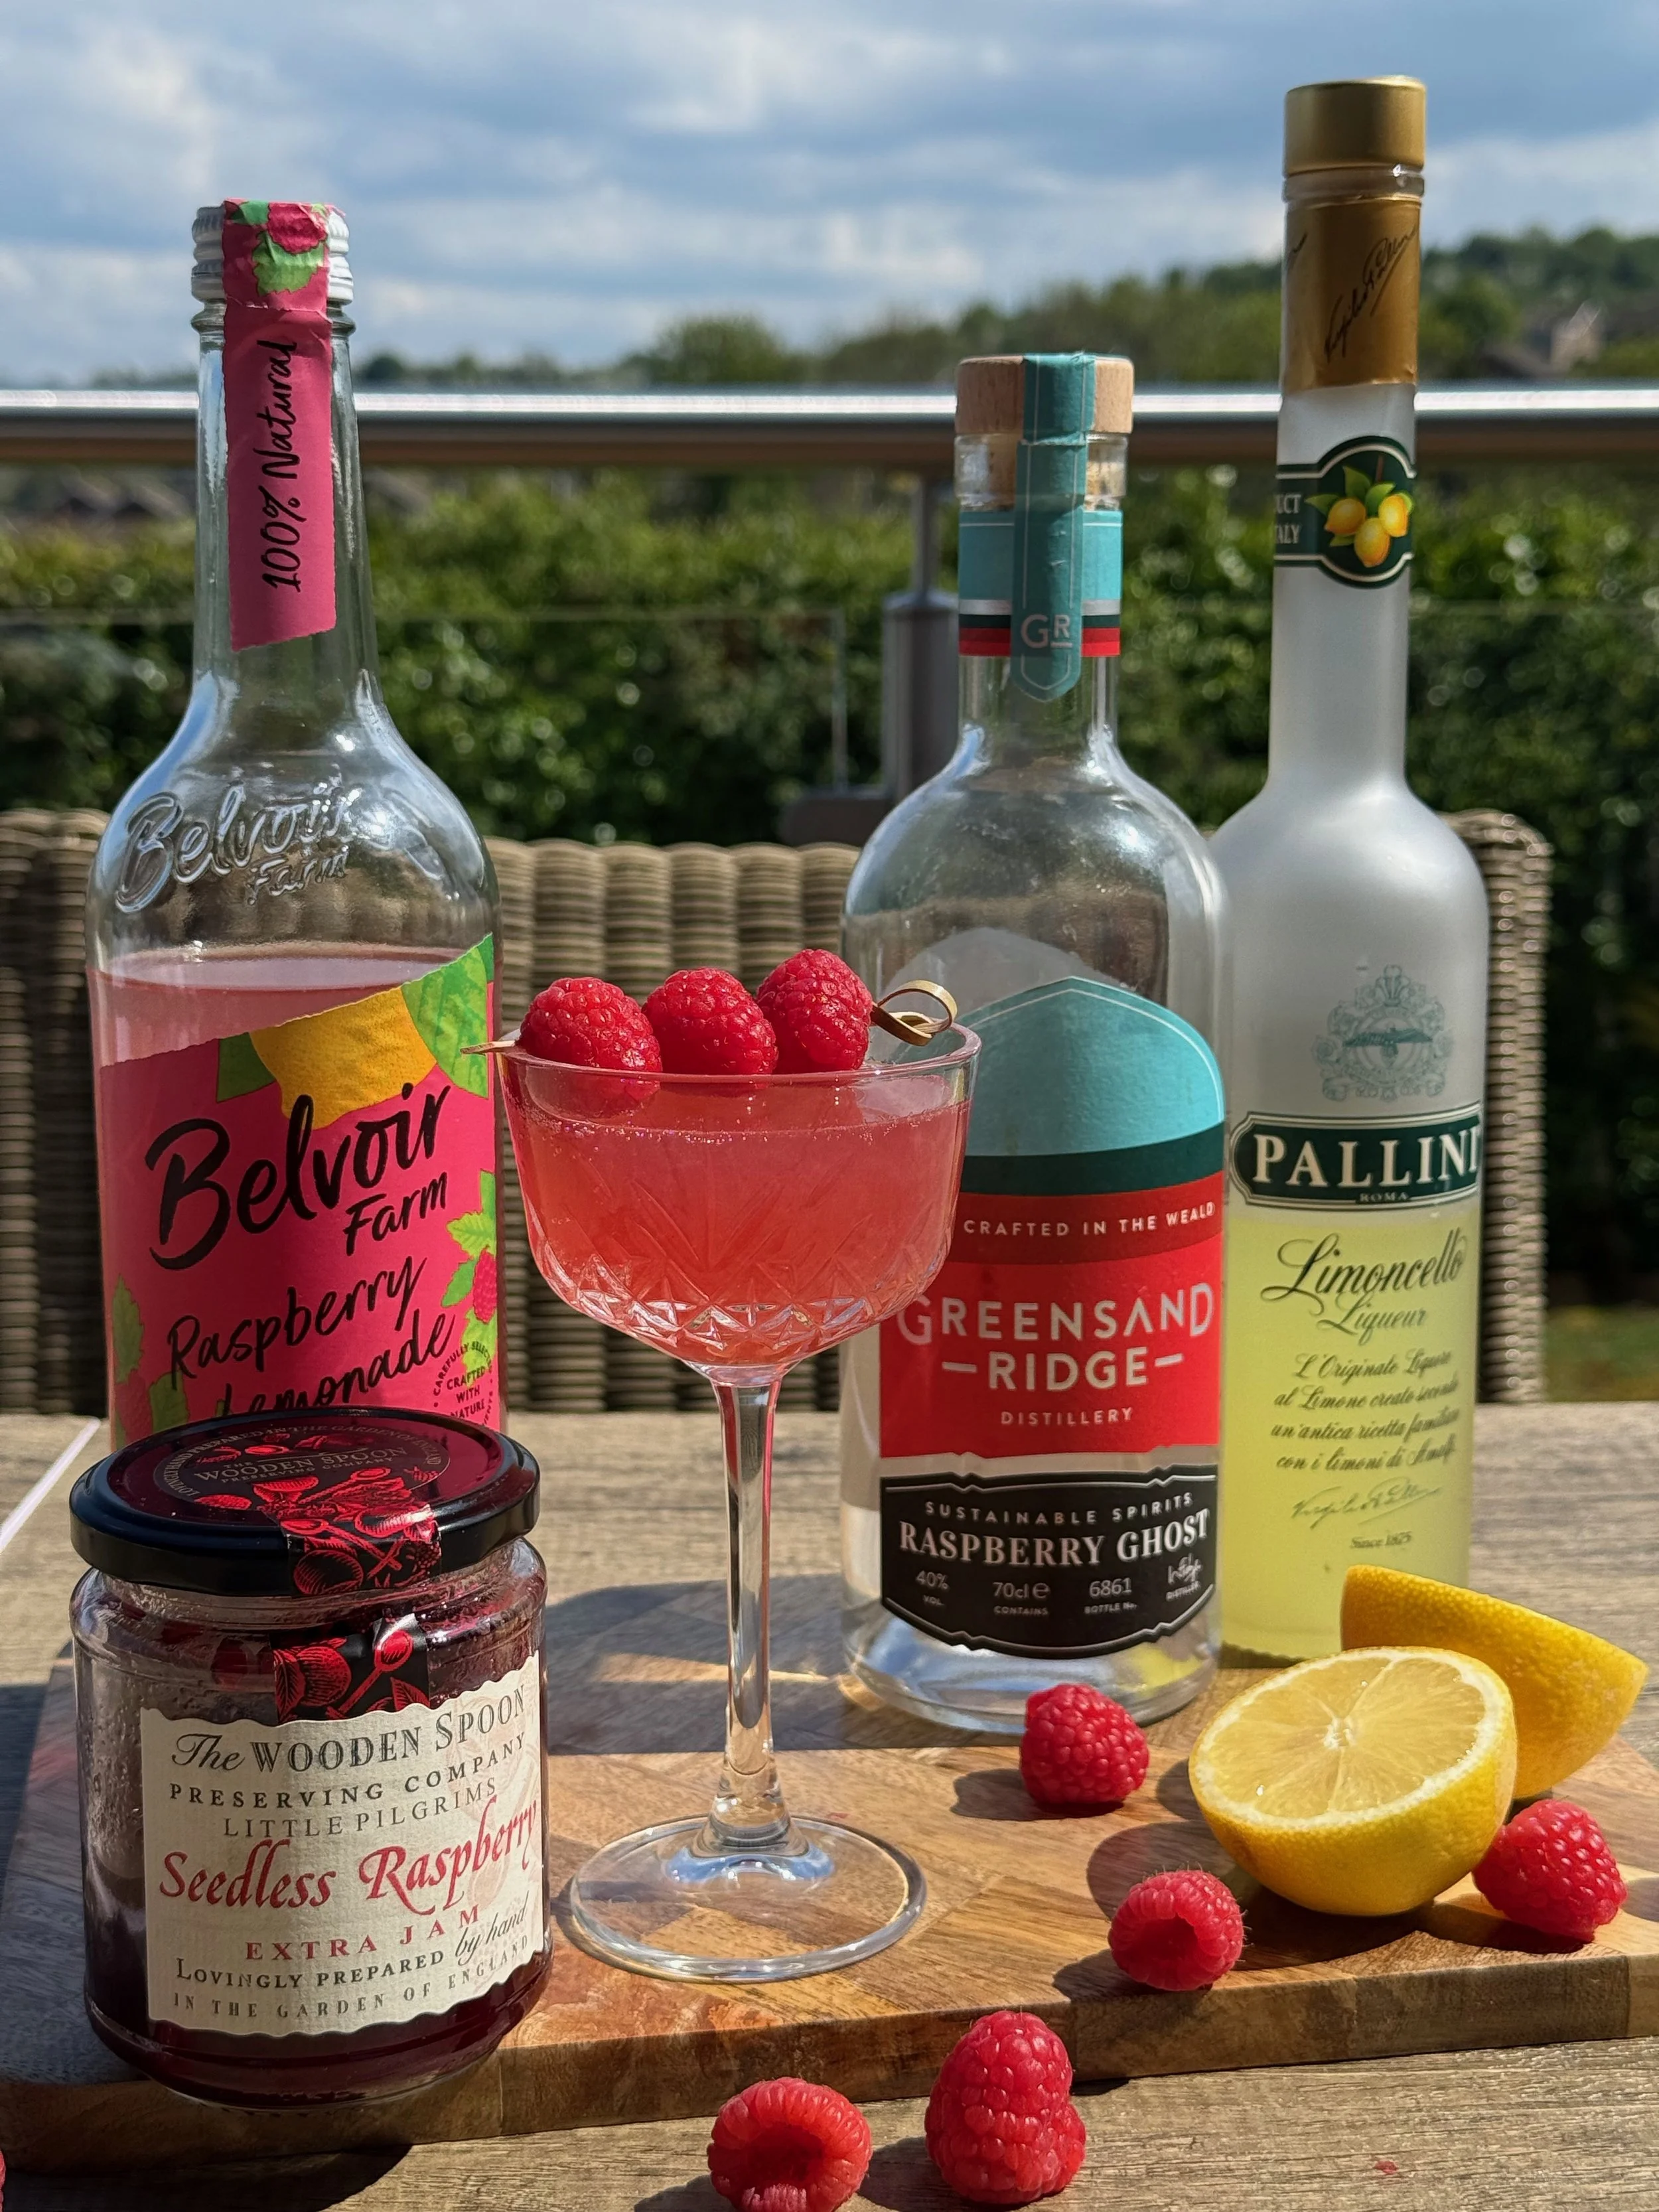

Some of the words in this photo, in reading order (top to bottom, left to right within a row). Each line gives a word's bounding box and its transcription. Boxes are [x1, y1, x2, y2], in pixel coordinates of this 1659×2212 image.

[253, 340, 300, 479] Natural
[258, 485, 307, 593] 100%
[145, 1082, 452, 1270] Belvoir
[1252, 1126, 1480, 1188] PALLINI
[343, 1172, 448, 1256] Farm
[964, 1219, 1070, 1236] CRAFTED
[1083, 1220, 1107, 1235] IN
[1119, 1215, 1158, 1232] THE
[1165, 1201, 1216, 1226] WEALD
[1261, 1226, 1467, 1316] Limoncello
[167, 1256, 427, 1391] Raspberry
[897, 1282, 1214, 1345] GREENSAND
[1317, 1291, 1427, 1346] Liqueur
[433, 1343, 469, 1396] CAREFULLY
[447, 1366, 486, 1390] CRAFTED
[456, 1384, 480, 1403] WITH
[1001, 1408, 1133, 1426] DISTILLERY
[194, 1459, 315, 1481] WOODEN
[321, 1447, 408, 1465] SPOON
[221, 1467, 316, 1483] PRESERVING
[323, 1457, 393, 1469] COMPANY
[899, 1520, 1105, 1567] RASPBERRY
[1116, 1508, 1210, 1562] GHOST
[925, 1501, 1097, 1524] SUSTAINABLE
[1112, 1492, 1193, 1521] SPIRITS
[916, 1570, 950, 1590] 40%
[1084, 1603, 1120, 1614] BOTTLE
[1090, 1577, 1132, 1598] 6861
[995, 1605, 1048, 1615] CONTAINS
[171, 1733, 246, 1771] The
[249, 1726, 421, 1773] WOODEN
[435, 1685, 526, 1751] SPOON
[169, 1783, 384, 1808] PRESERVING
[404, 1732, 526, 1793] COMPANY
[223, 1815, 344, 1838] LITTLE
[356, 1777, 498, 1832] PILGRIMS
[159, 1838, 337, 1909] Seedless
[358, 1795, 537, 1915] Raspberry
[176, 1957, 304, 1988] LOVINGLY
[317, 1950, 444, 1987] PREPARED
[455, 1928, 484, 1966] by
[485, 1891, 530, 1945] hand
[246, 1935, 378, 1960] EXTRA
[399, 1904, 480, 1945] JAM
[173, 1992, 195, 2010] IN
[211, 1999, 258, 2018] THE
[277, 1992, 386, 2018] GARDEN
[403, 1982, 431, 2002] OF
[447, 1934, 528, 1990] ENGLAND
